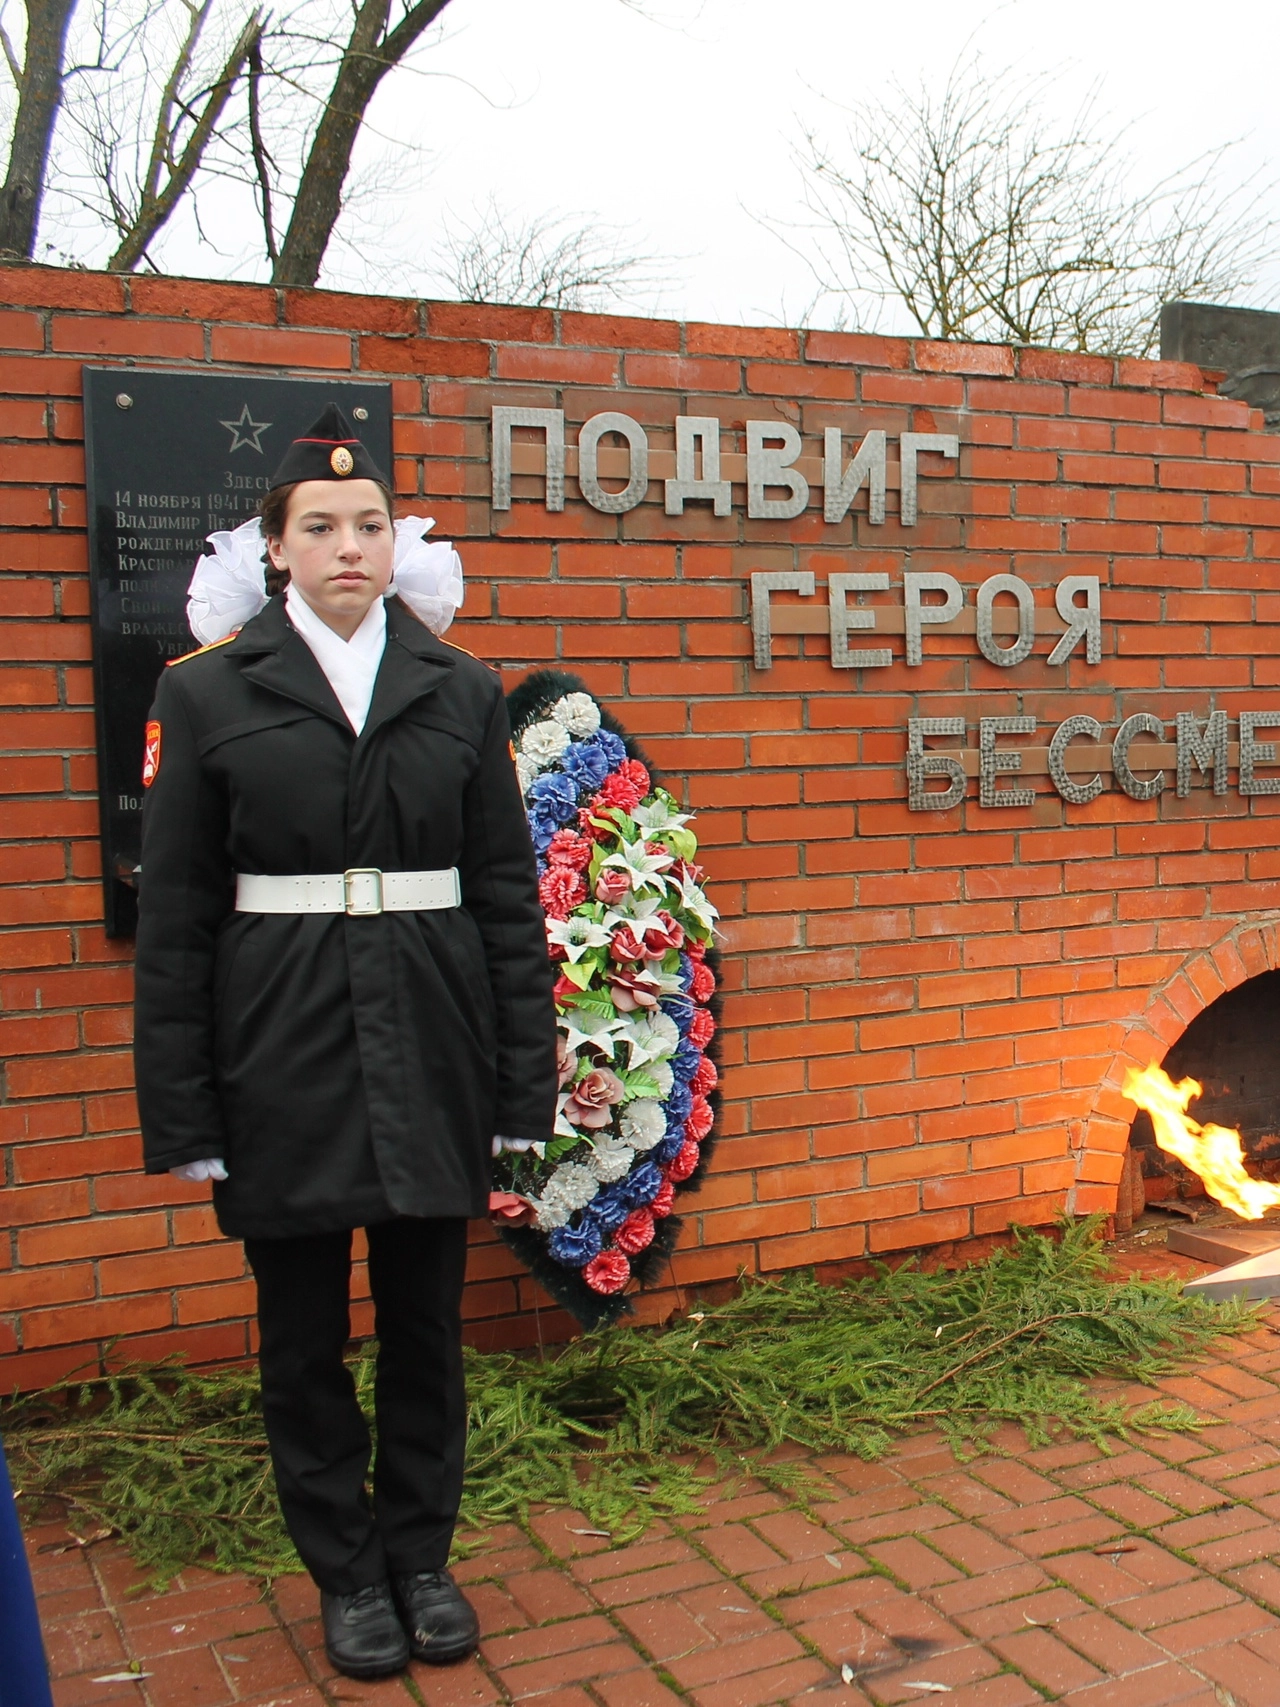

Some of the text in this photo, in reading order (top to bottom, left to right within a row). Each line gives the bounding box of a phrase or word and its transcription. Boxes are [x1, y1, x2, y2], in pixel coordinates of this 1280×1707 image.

[114, 489, 131, 507] 14
[207, 493, 239, 511] 1941
[491, 405, 960, 527] ПОДВИГ
[750, 571, 1101, 669] ГЕРОЯ
